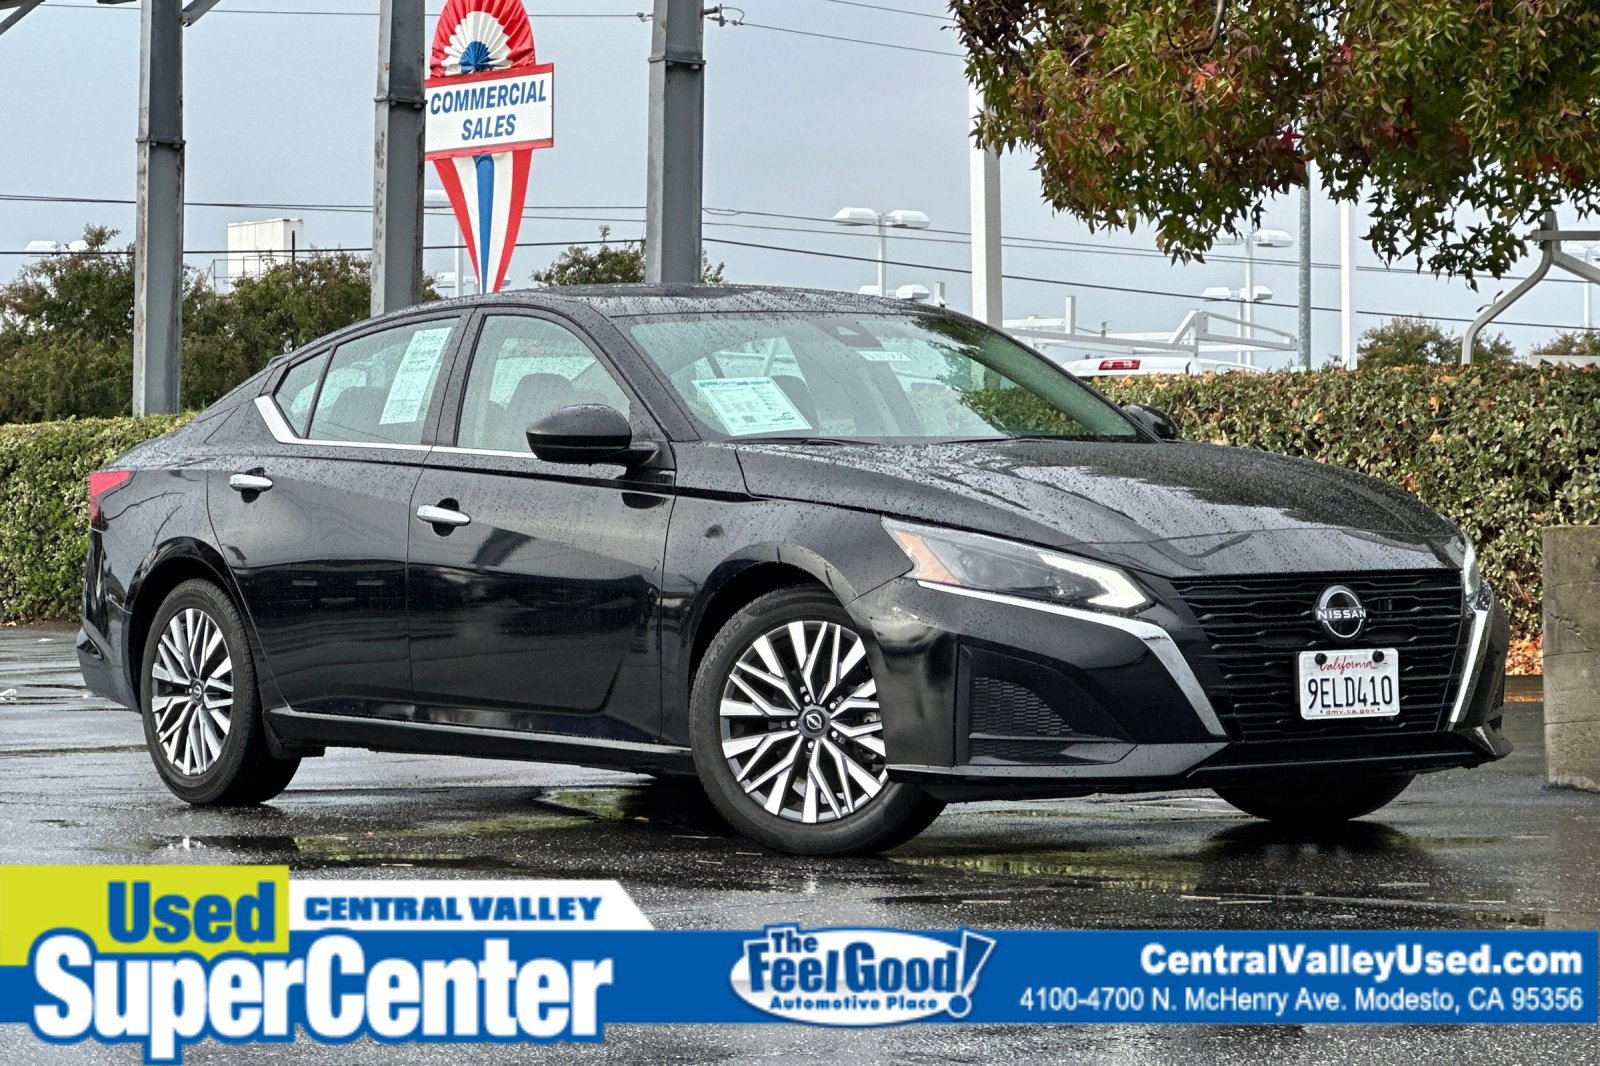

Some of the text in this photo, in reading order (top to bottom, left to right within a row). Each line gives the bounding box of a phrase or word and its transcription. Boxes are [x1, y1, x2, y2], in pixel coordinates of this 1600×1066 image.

[430, 80, 547, 115] COMMERCIAL
[461, 113, 517, 141] SALES
[1317, 608, 1367, 620] NISSAN
[1307, 675, 1393, 709] 9ELD410
